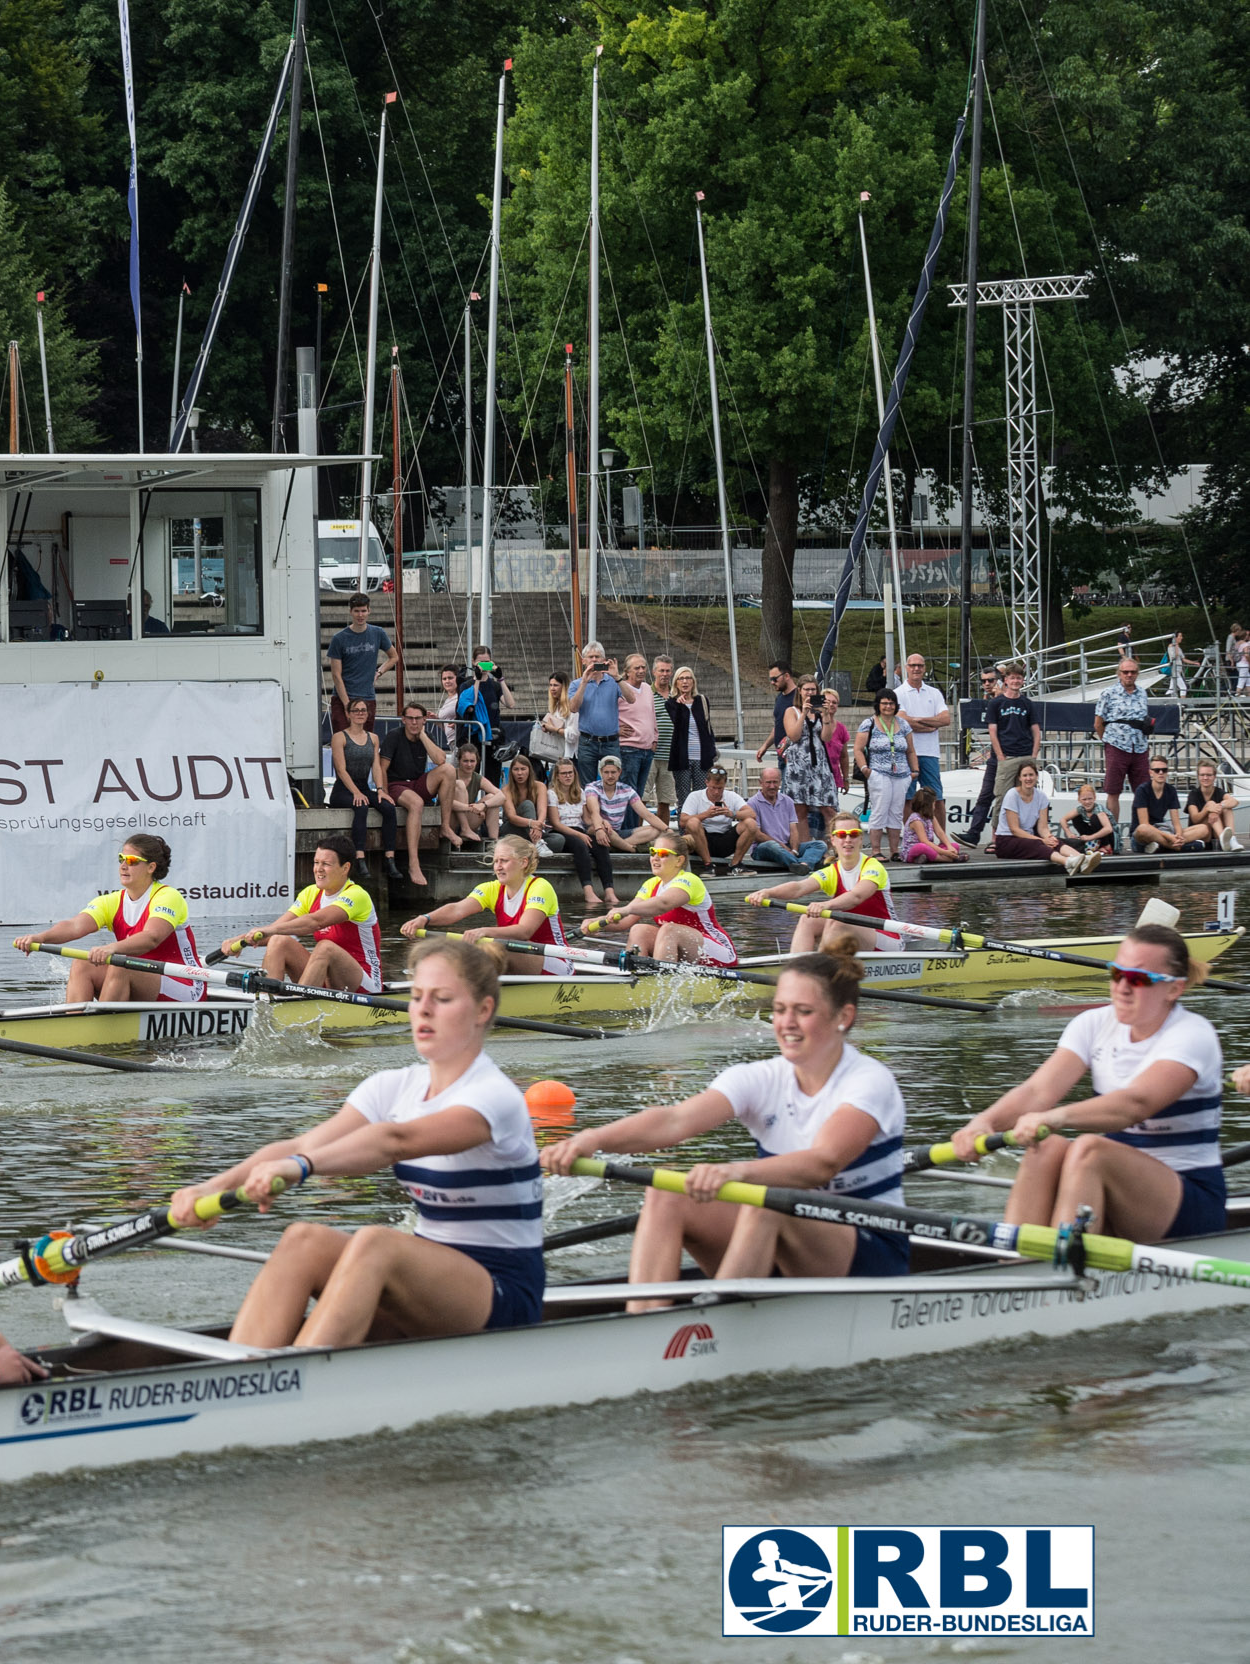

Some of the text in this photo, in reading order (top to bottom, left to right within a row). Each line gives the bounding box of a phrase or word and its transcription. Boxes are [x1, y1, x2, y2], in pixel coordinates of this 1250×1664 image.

[92, 755, 282, 803] AUDIT
[161, 906, 176, 917] RBL
[1221, 895, 1228, 918] 1
[927, 959, 934, 970] Z
[935, 959, 947, 970] BS
[286, 985, 306, 993] STARK.
[307, 987, 335, 998] SCHNELL.
[335, 992, 350, 1001] GUT.
[551, 984, 580, 1004] Melitta
[146, 1010, 248, 1039] MINDEN
[795, 1203, 843, 1222] STARK.
[845, 1212, 912, 1234] SCHNELL.
[913, 1223, 948, 1239] GUT.
[890, 1294, 964, 1330] Talente
[49, 1369, 300, 1414] RBL RUDER-BUNDESLIGA
